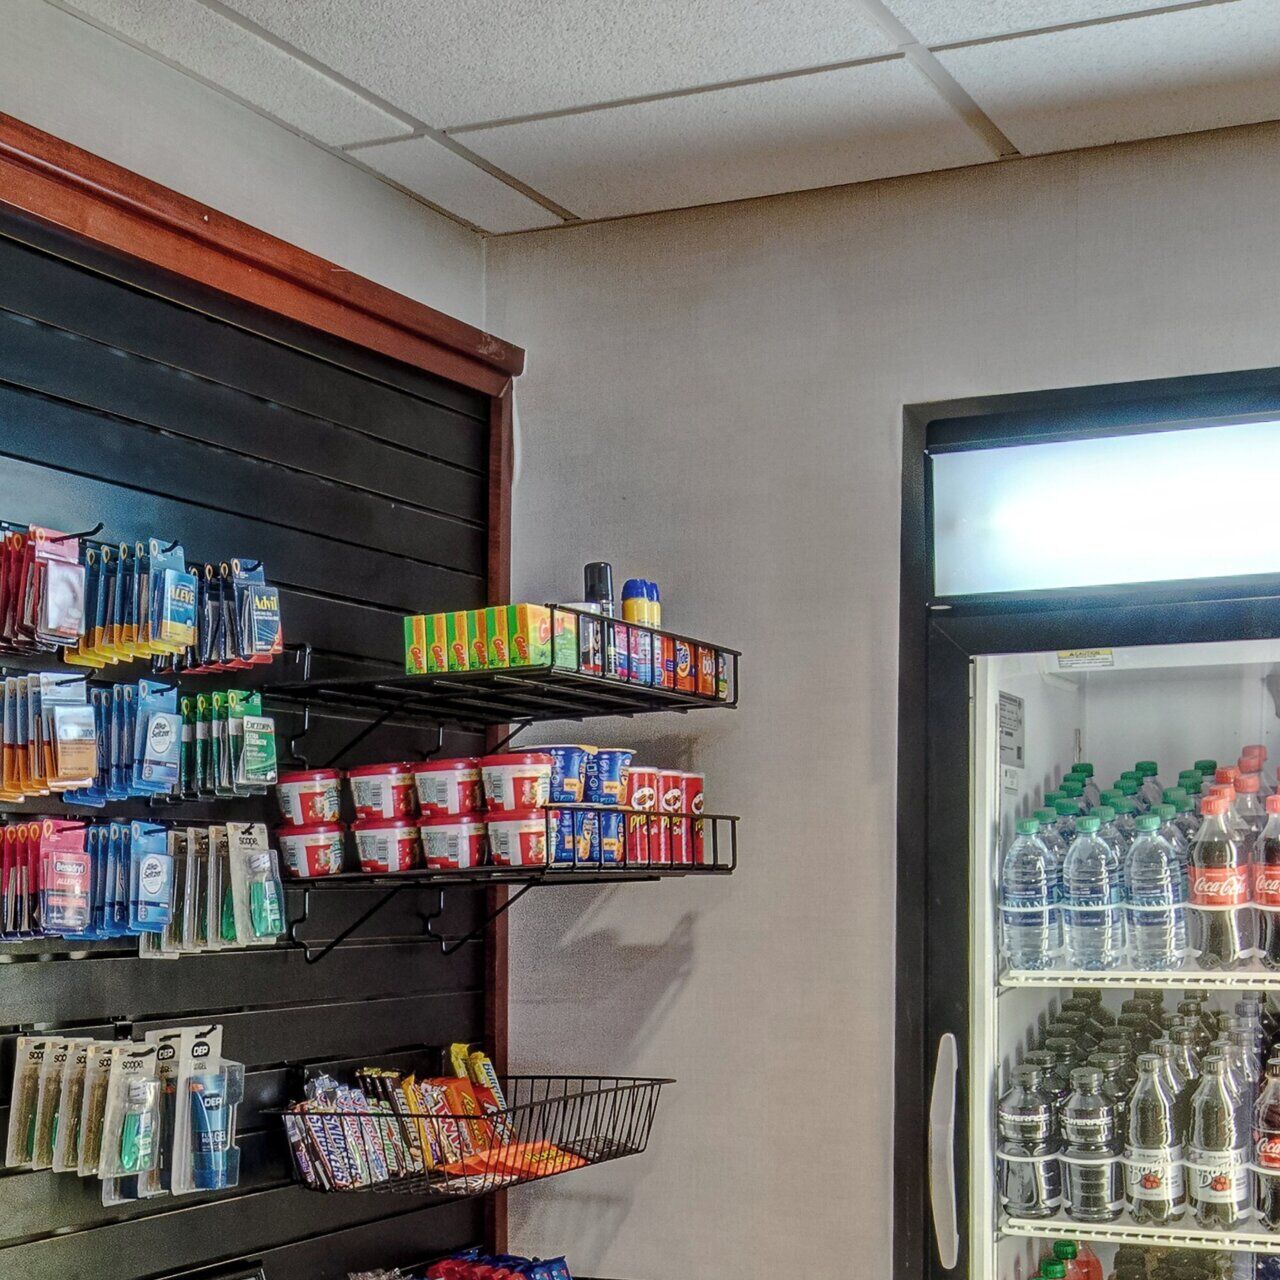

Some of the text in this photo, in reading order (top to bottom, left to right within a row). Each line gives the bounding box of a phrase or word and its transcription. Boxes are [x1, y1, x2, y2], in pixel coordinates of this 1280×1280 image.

[170, 586, 195, 603] ALEVE
[254, 595, 278, 611] Advil
[151, 728, 170, 739] Seltzer
[55, 862, 85, 874] Benadryl
[1194, 874, 1248, 897] Coca-Cola
[157, 1048, 174, 1059] DEP
[192, 1045, 209, 1057] DEP
[122, 1060, 144, 1070] scope
[204, 1096, 225, 1108] DEP
